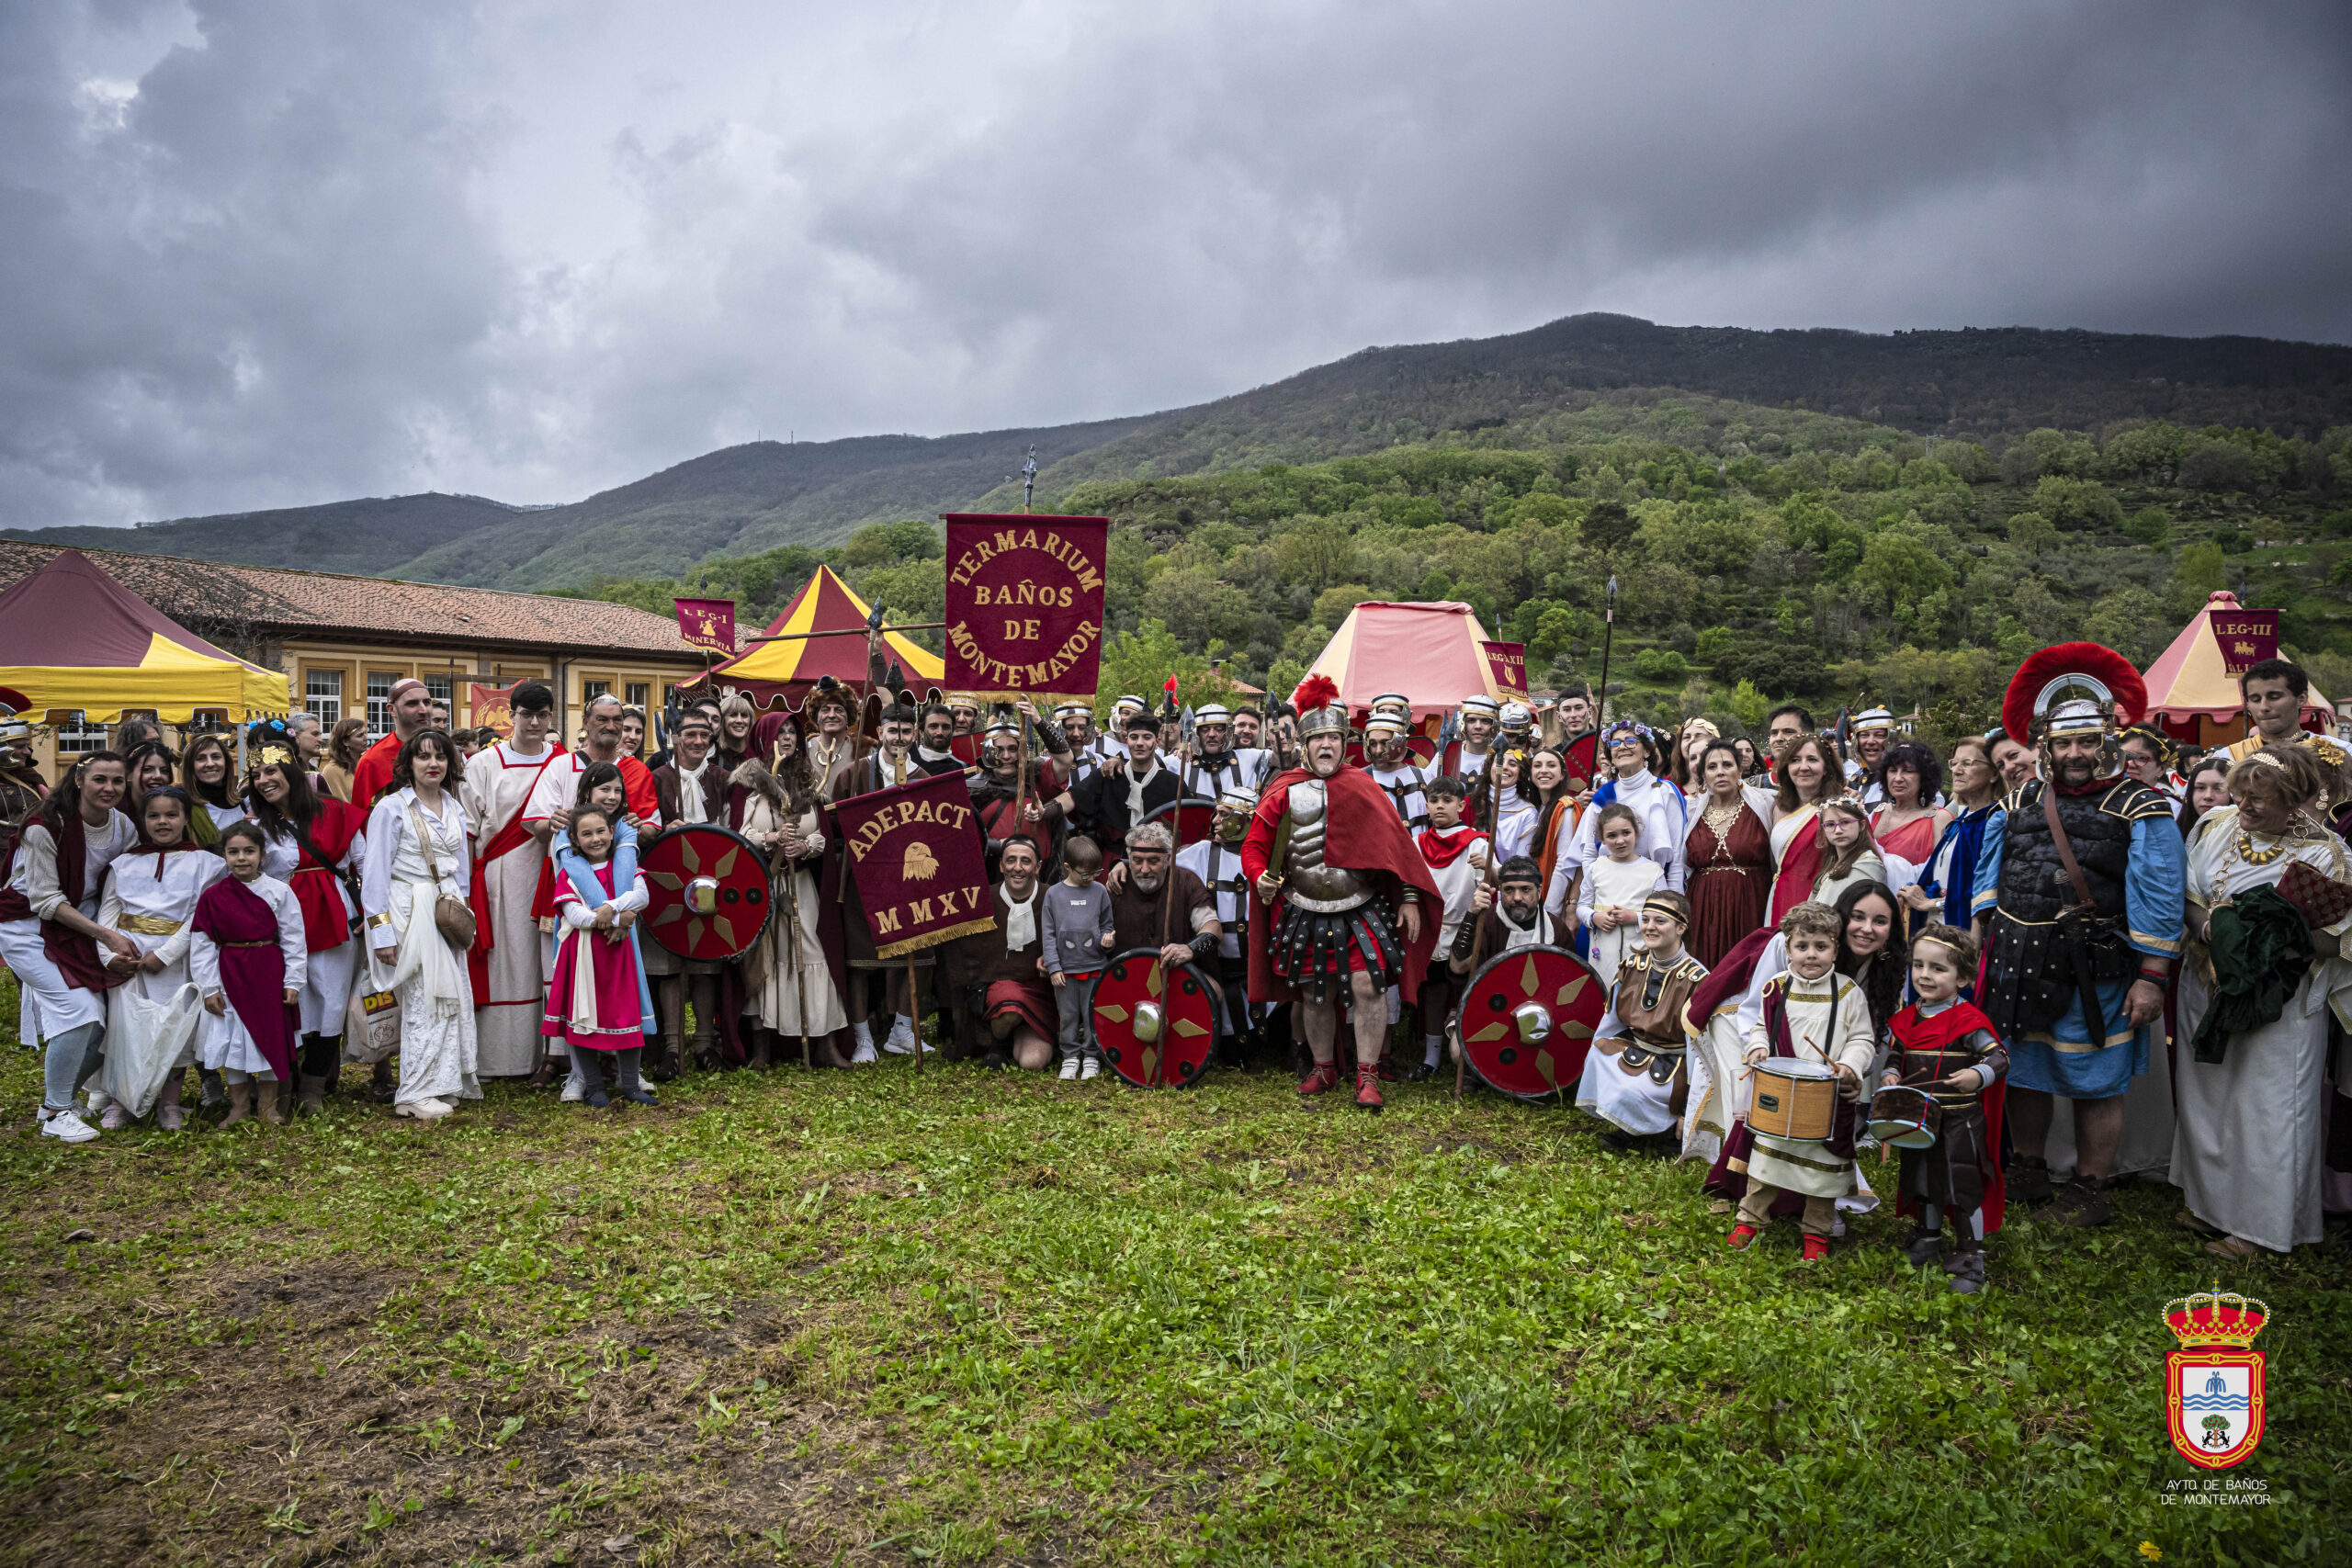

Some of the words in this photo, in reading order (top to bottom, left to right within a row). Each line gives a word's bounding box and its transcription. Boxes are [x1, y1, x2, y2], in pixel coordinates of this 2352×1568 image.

[950, 529, 1102, 592] TERMARIUM
[974, 579, 1073, 607] BAÑOS
[684, 608, 727, 624] LEG-I
[1004, 619, 1041, 640] DE
[2215, 624, 2272, 636] LEG-III
[684, 632, 731, 652] MINERVIA
[947, 620, 1101, 687] MONTEMAYOR
[848, 800, 971, 863] ADEPACT
